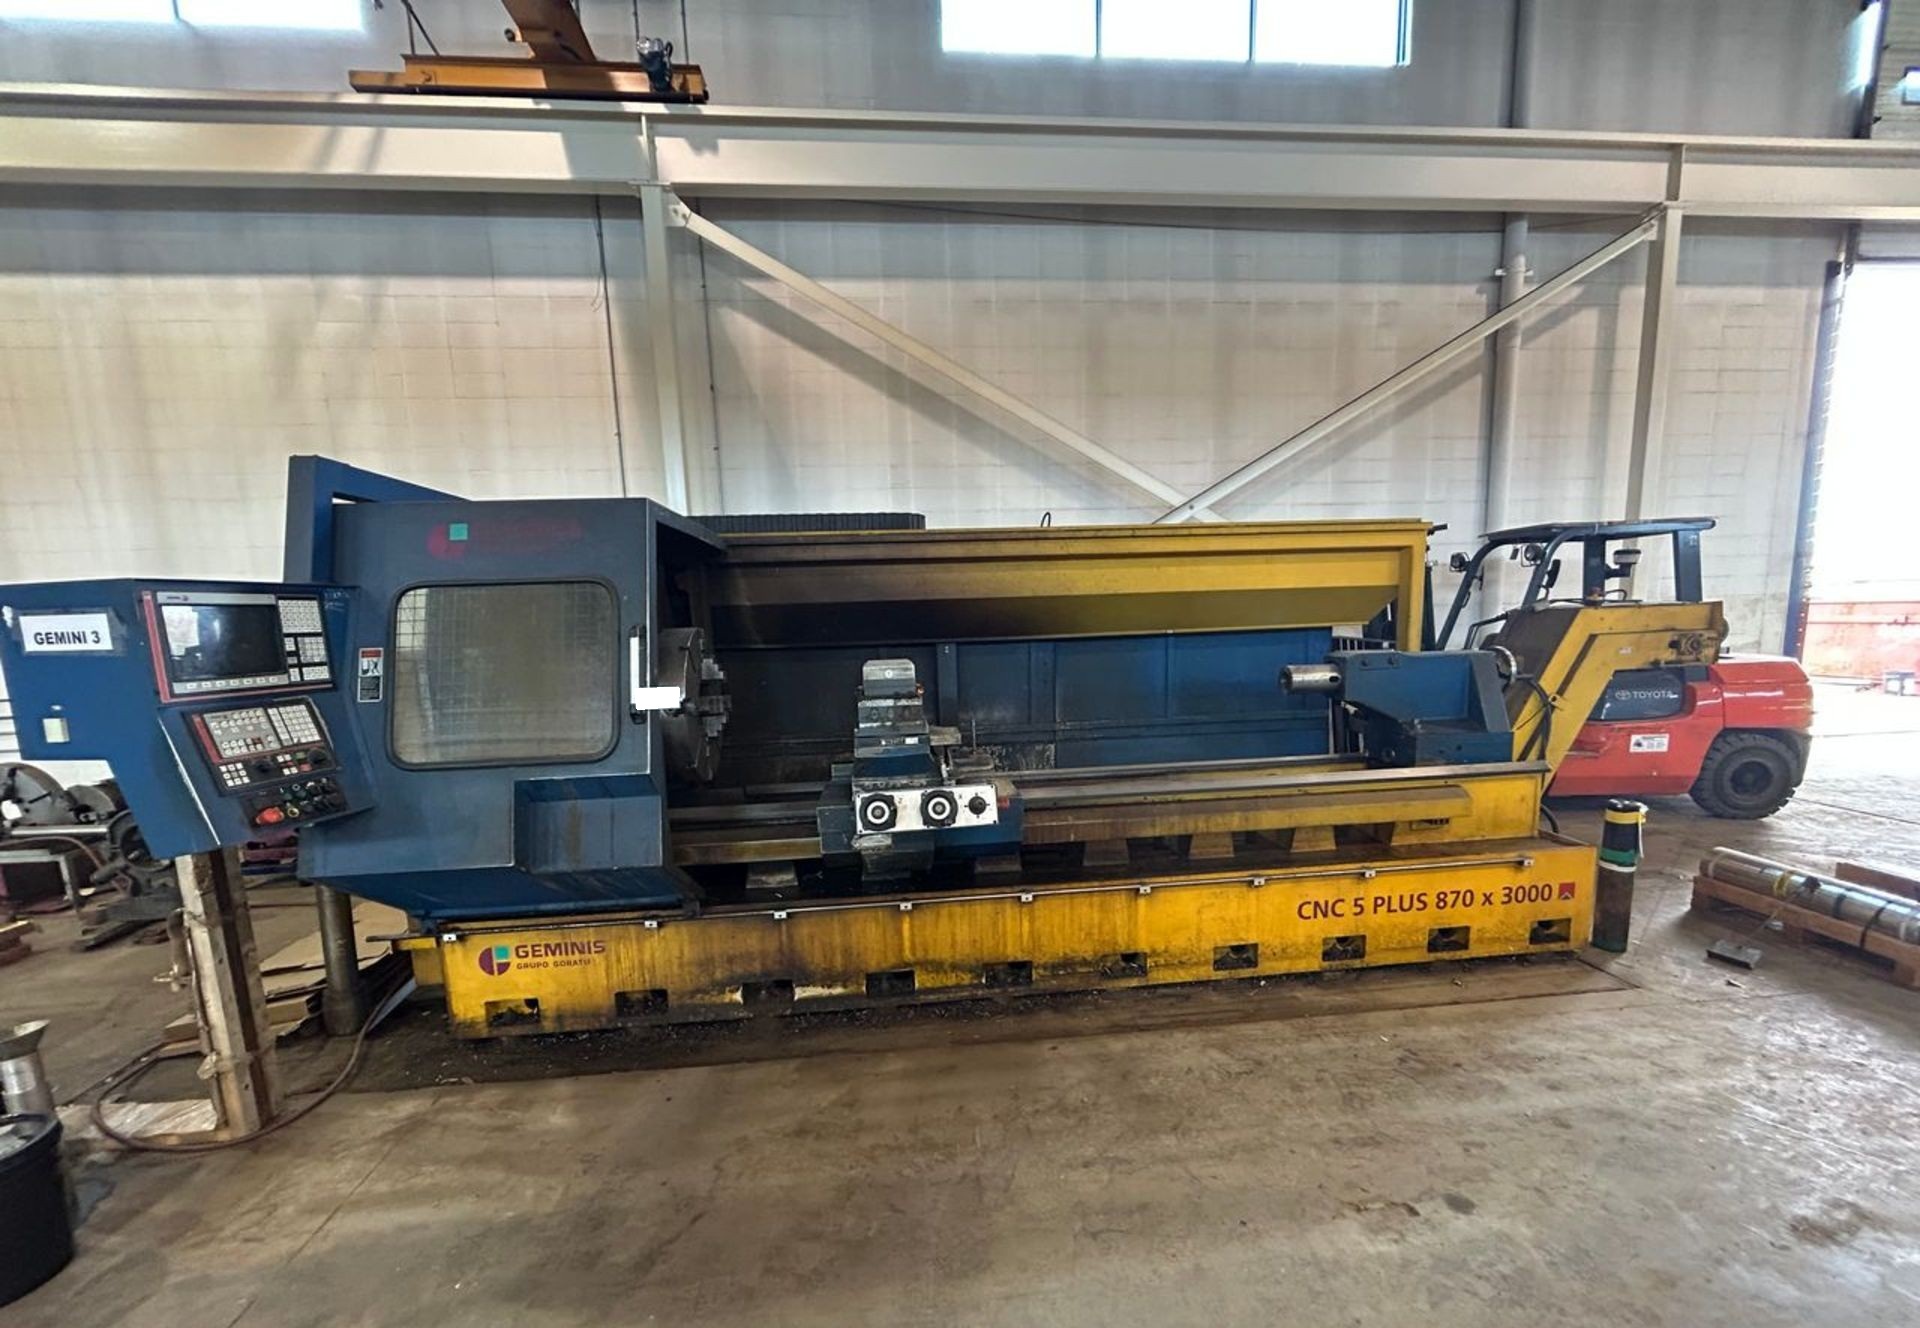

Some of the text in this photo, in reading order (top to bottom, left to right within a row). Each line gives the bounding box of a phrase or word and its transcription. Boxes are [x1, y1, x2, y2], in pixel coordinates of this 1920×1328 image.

[33, 630, 101, 646] GEMINI 3
[1632, 690, 1674, 699] TOYOTA
[1297, 883, 1552, 920] CNC 5 PLUS 870 x 3000
[514, 940, 606, 958] GEMINIS
[516, 961, 549, 969] GRUPO
